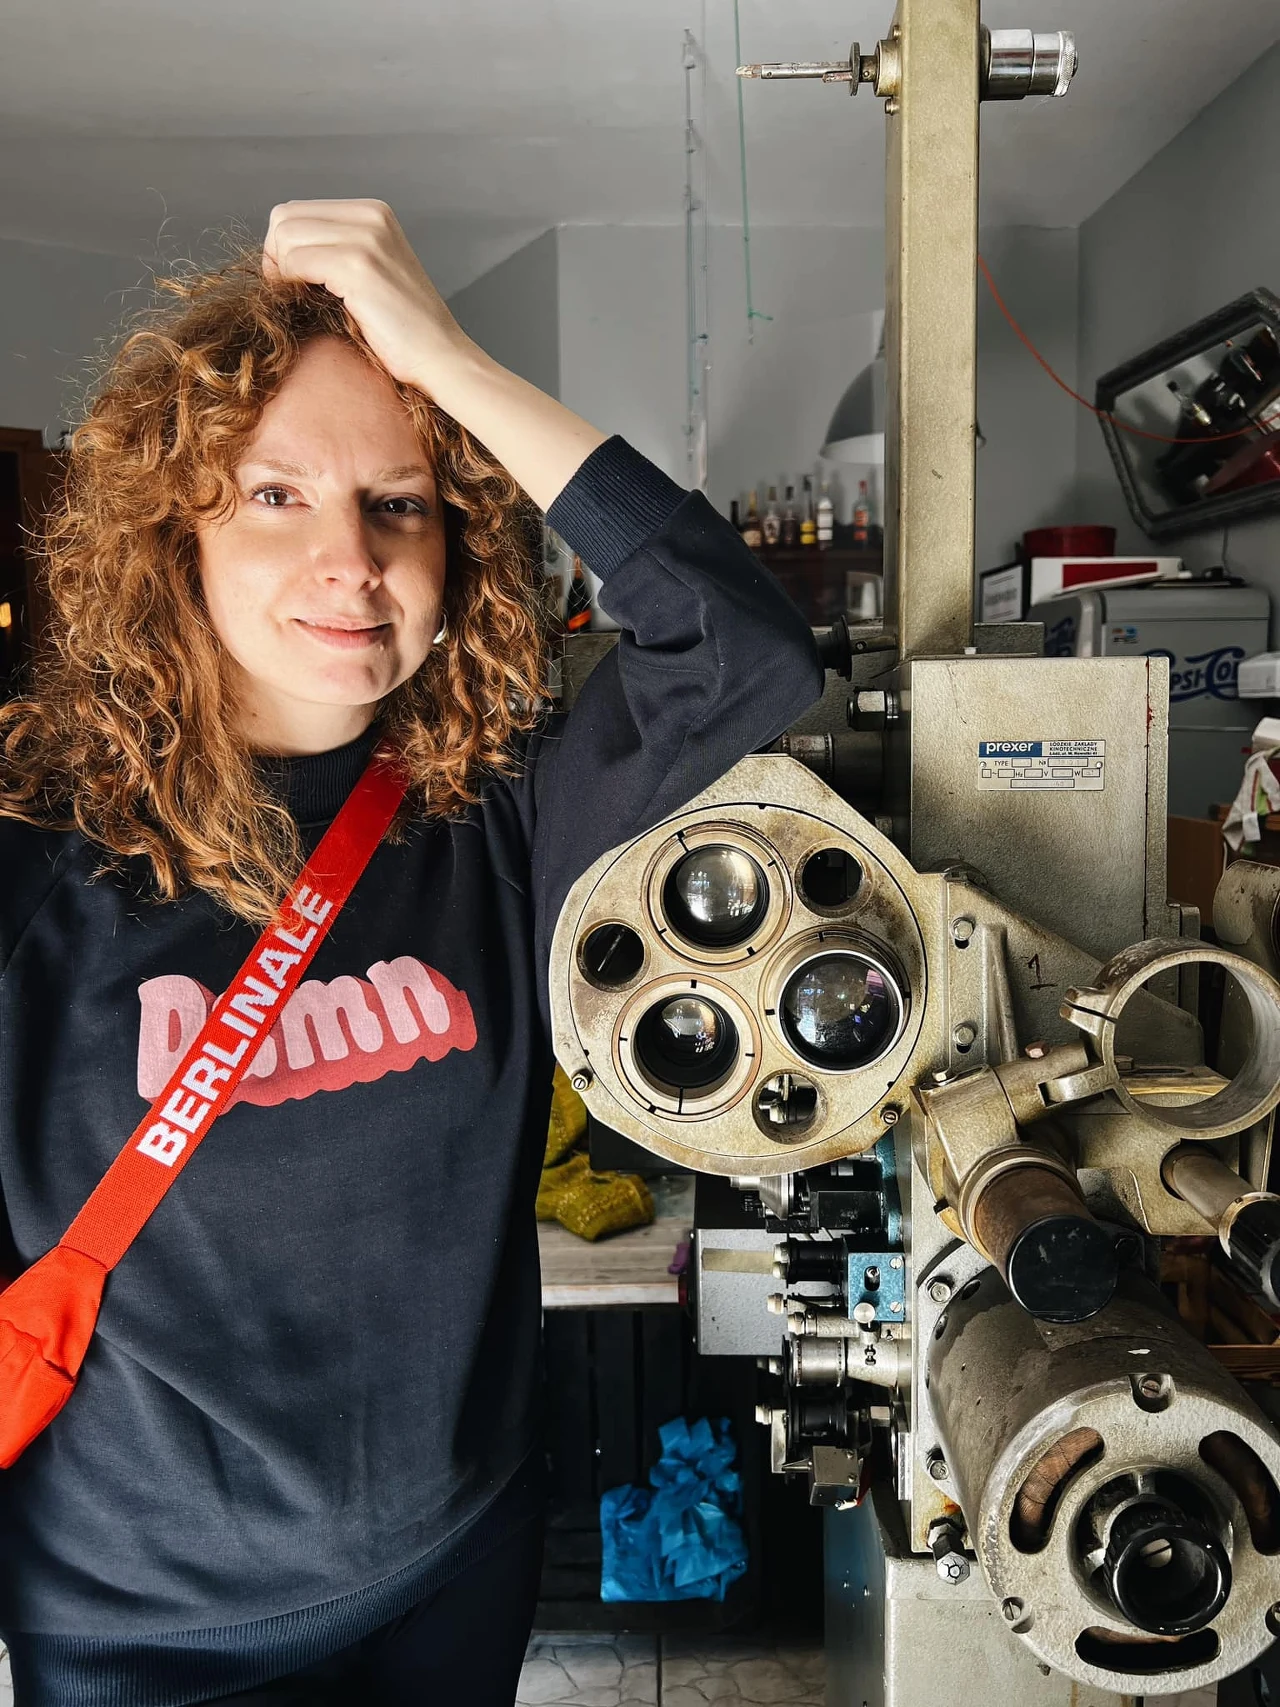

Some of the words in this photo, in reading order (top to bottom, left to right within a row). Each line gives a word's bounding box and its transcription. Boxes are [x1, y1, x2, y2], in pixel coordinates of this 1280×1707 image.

[986, 742, 1033, 754] prexer
[1027, 953, 1058, 990] 1
[136, 884, 333, 1168] BERLINALE
[137, 955, 478, 1116] Dmn
